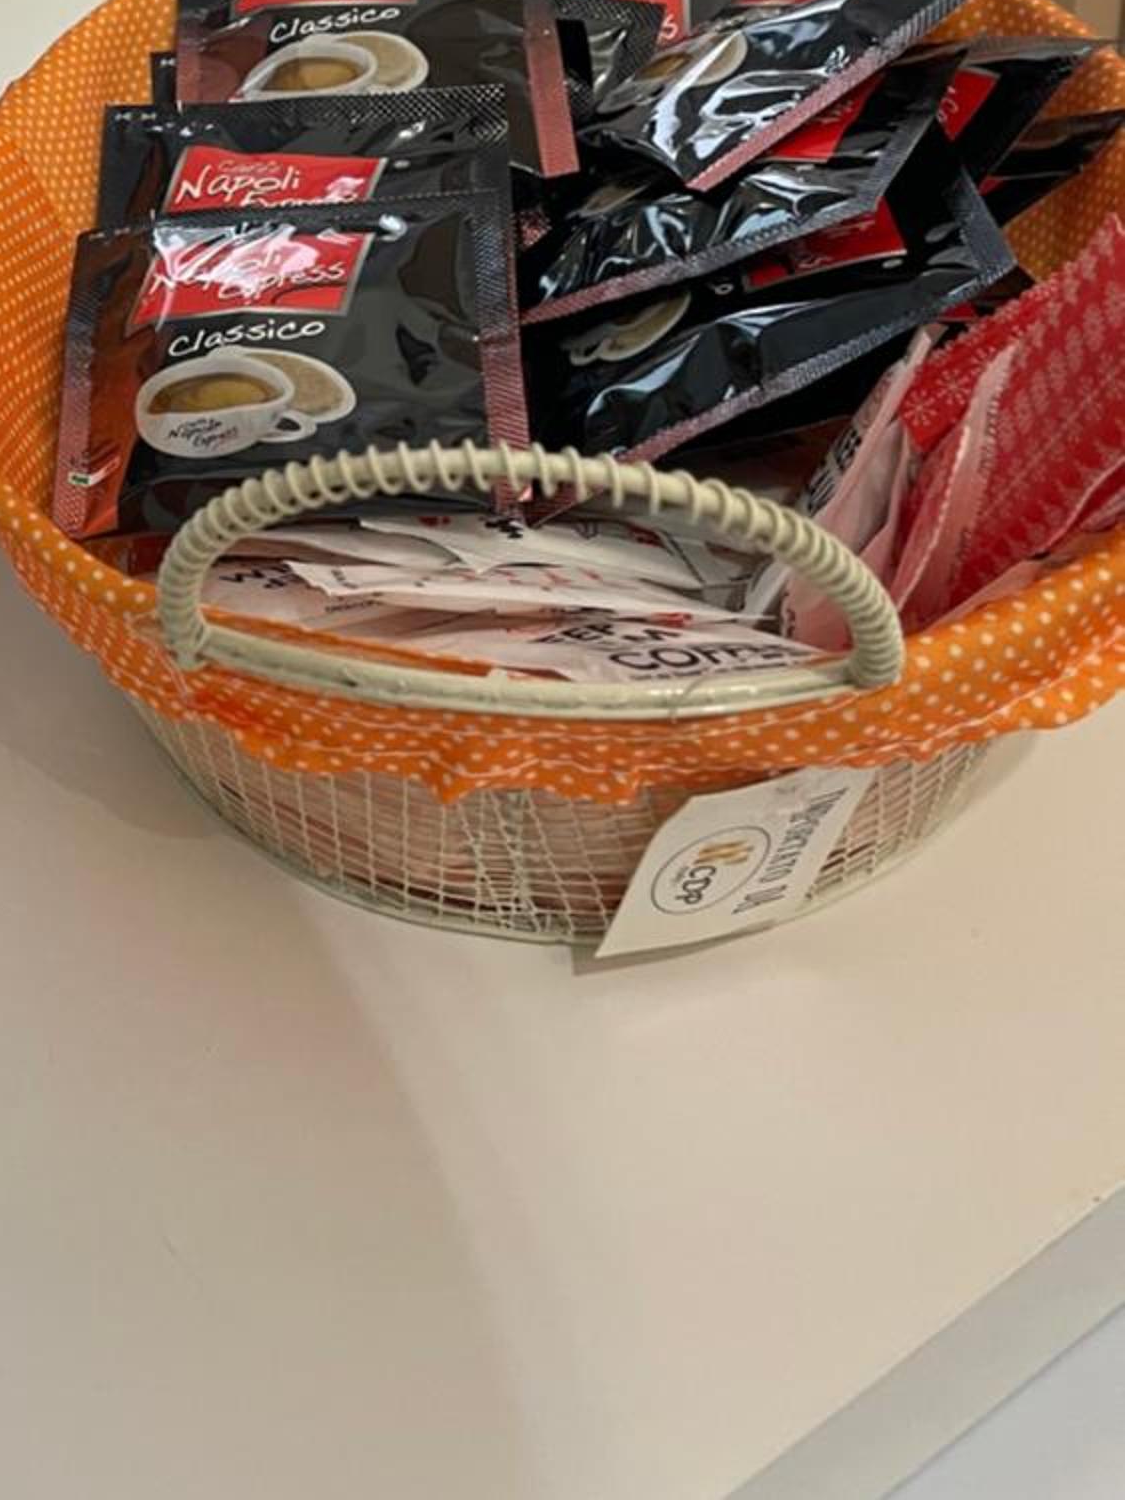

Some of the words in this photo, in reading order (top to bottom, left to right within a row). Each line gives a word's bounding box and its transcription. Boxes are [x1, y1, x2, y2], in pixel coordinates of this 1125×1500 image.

[269, 7, 401, 43] Classico
[174, 164, 302, 204] Napoli
[167, 318, 326, 357] Classico
[675, 865, 717, 905] CDP
